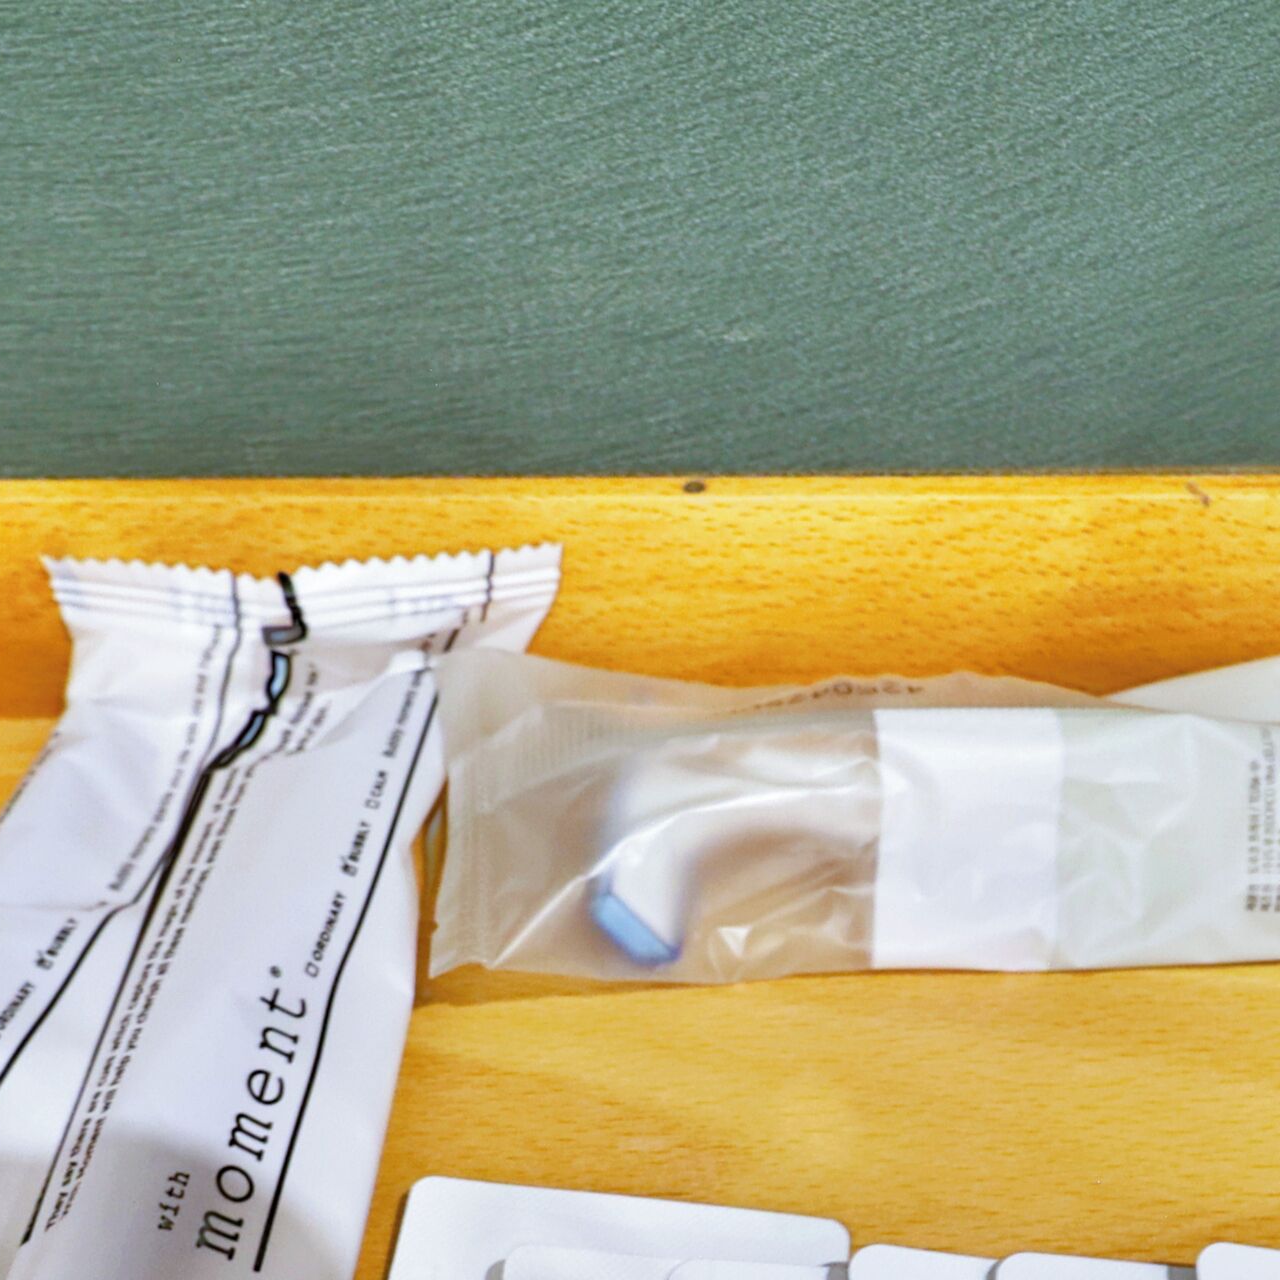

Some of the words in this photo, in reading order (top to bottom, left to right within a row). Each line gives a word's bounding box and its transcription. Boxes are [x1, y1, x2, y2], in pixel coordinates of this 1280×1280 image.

[312, 892, 346, 961] ORDINARY
[196, 988, 307, 1262] moment
[158, 1169, 190, 1232] with
